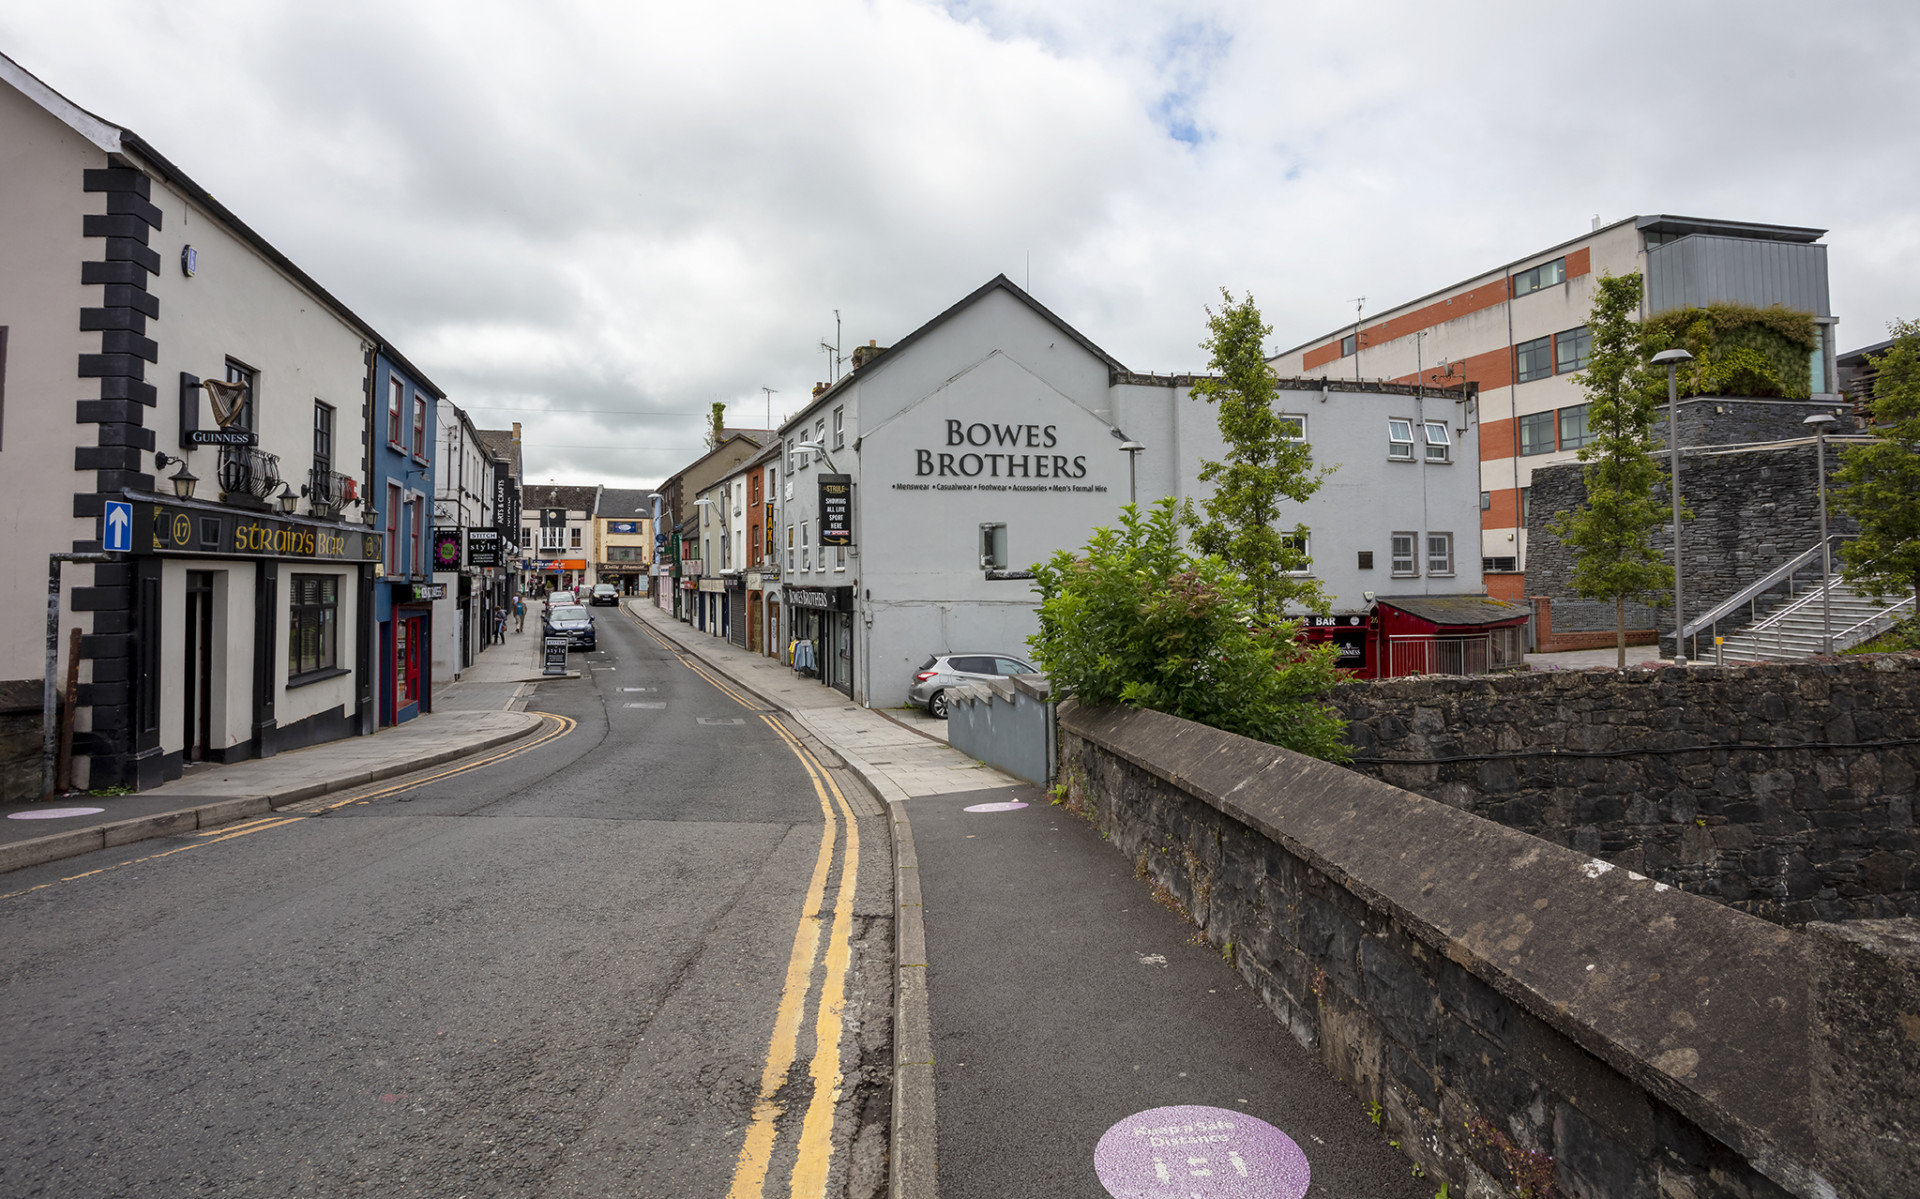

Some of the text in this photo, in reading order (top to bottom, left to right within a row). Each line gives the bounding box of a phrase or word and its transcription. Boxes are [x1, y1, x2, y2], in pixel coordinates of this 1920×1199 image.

[192, 431, 249, 443] GUINNESS
[945, 419, 1057, 449] BOWES
[915, 449, 1087, 479] BROTHERS
[896, 483, 1108, 493] Menswear Casualwear Footwear Accessories Men's Formal Hire
[176, 522, 188, 538] 17
[470, 543, 496, 552] style
[1315, 617, 1336, 626] BAR
[1370, 616, 1378, 624] 26
